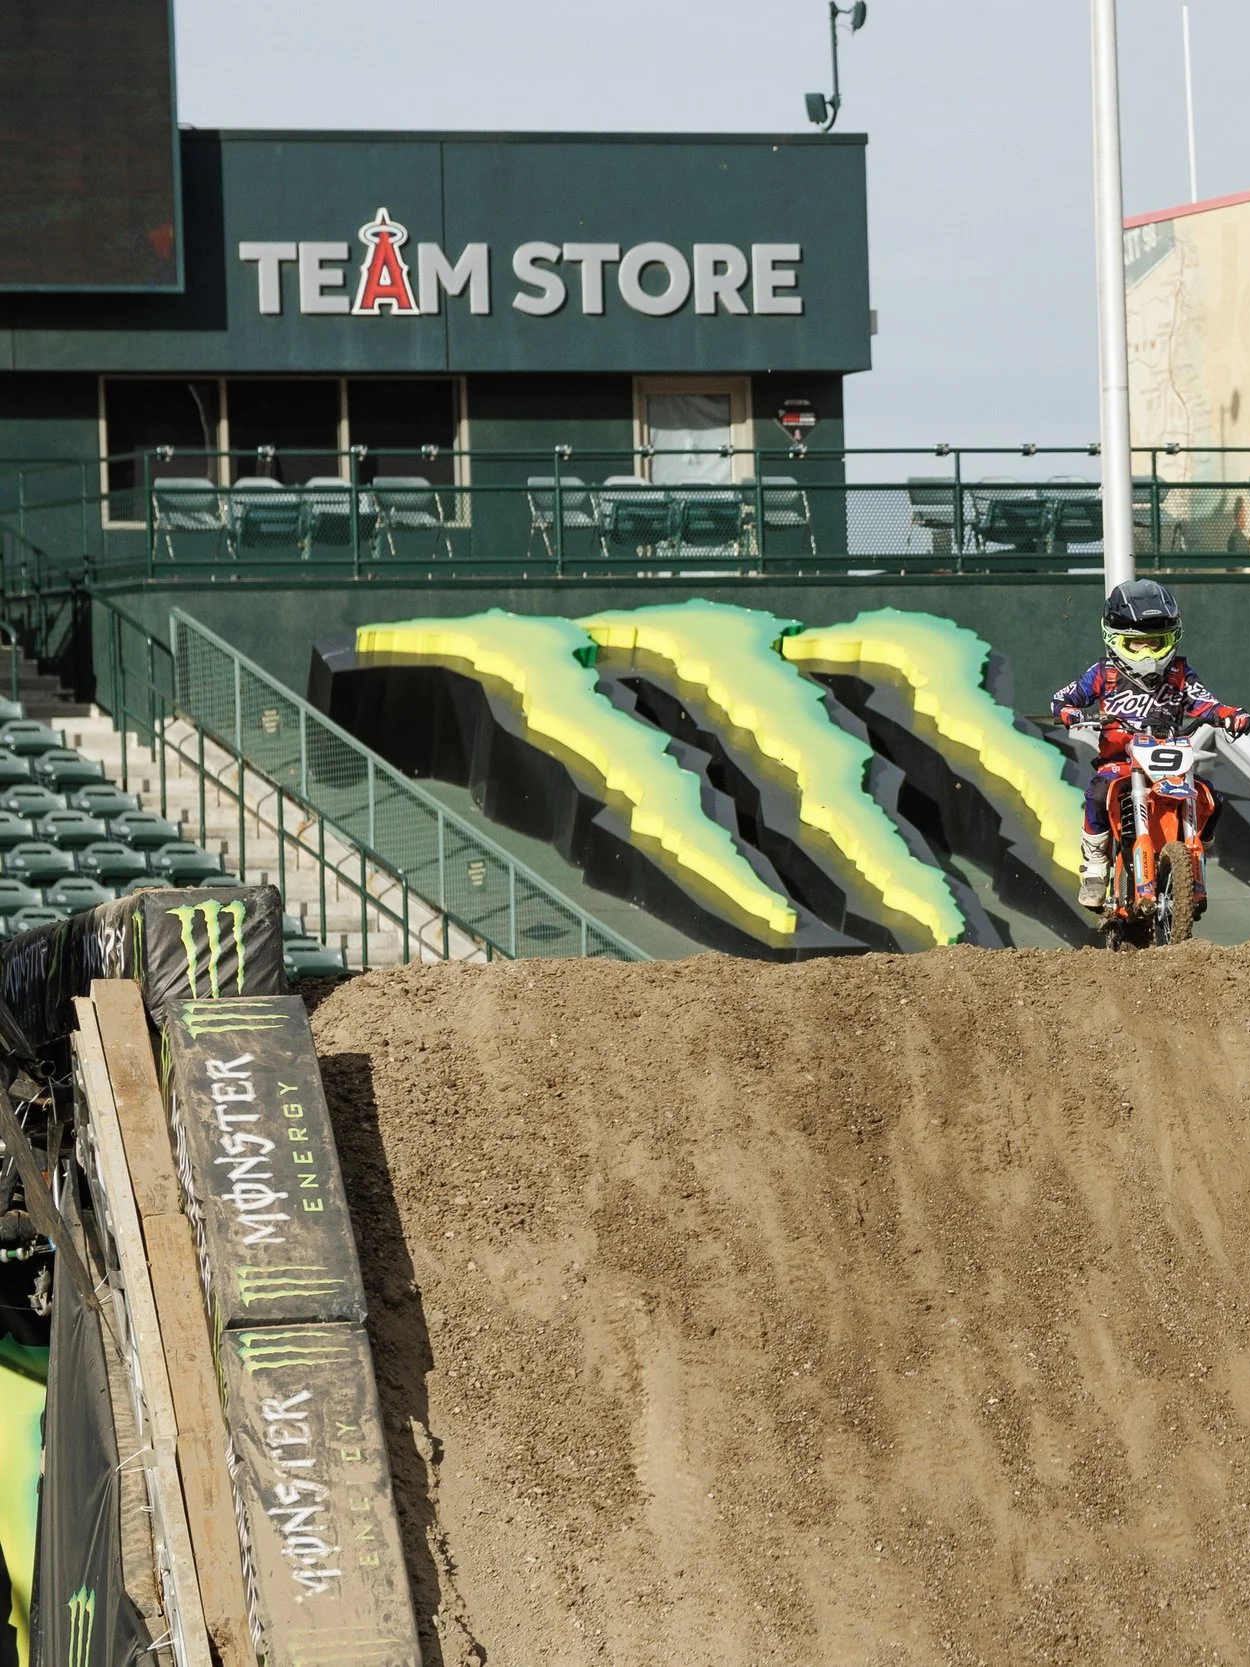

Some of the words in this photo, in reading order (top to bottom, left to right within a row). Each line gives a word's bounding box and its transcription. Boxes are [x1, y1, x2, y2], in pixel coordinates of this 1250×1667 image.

[239, 207, 489, 315] TEAM
[512, 241, 803, 316] STORE
[1148, 748, 1184, 772] 9
[204, 1051, 292, 1246] MONSTER
[277, 1081, 324, 1213] ENERGY
